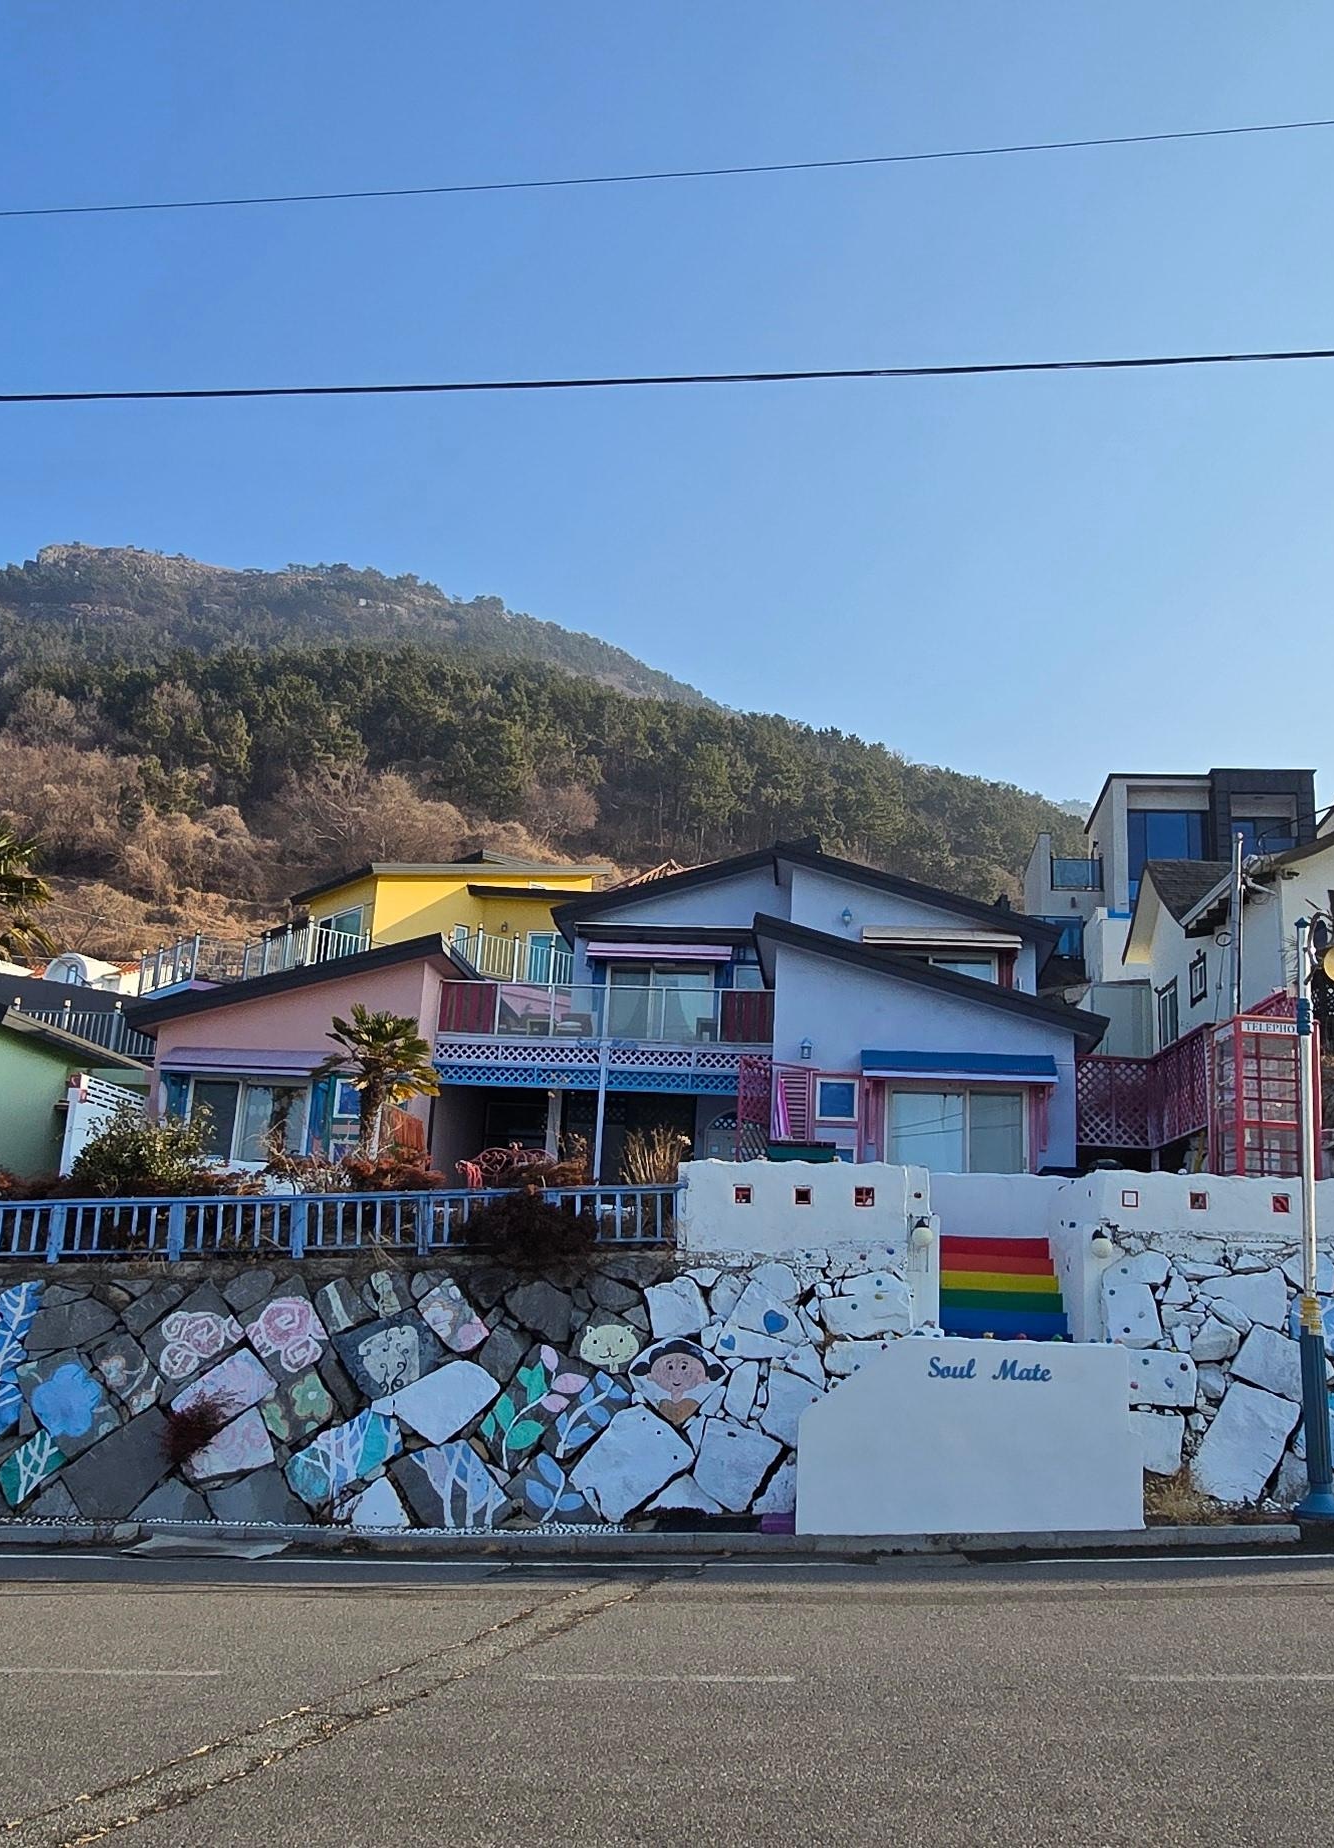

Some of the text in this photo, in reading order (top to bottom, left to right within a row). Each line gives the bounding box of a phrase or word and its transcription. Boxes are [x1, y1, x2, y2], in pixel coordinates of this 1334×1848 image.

[1245, 1022, 1295, 1033] TELEPHO
[927, 1356, 1052, 1382] Soul Mate
